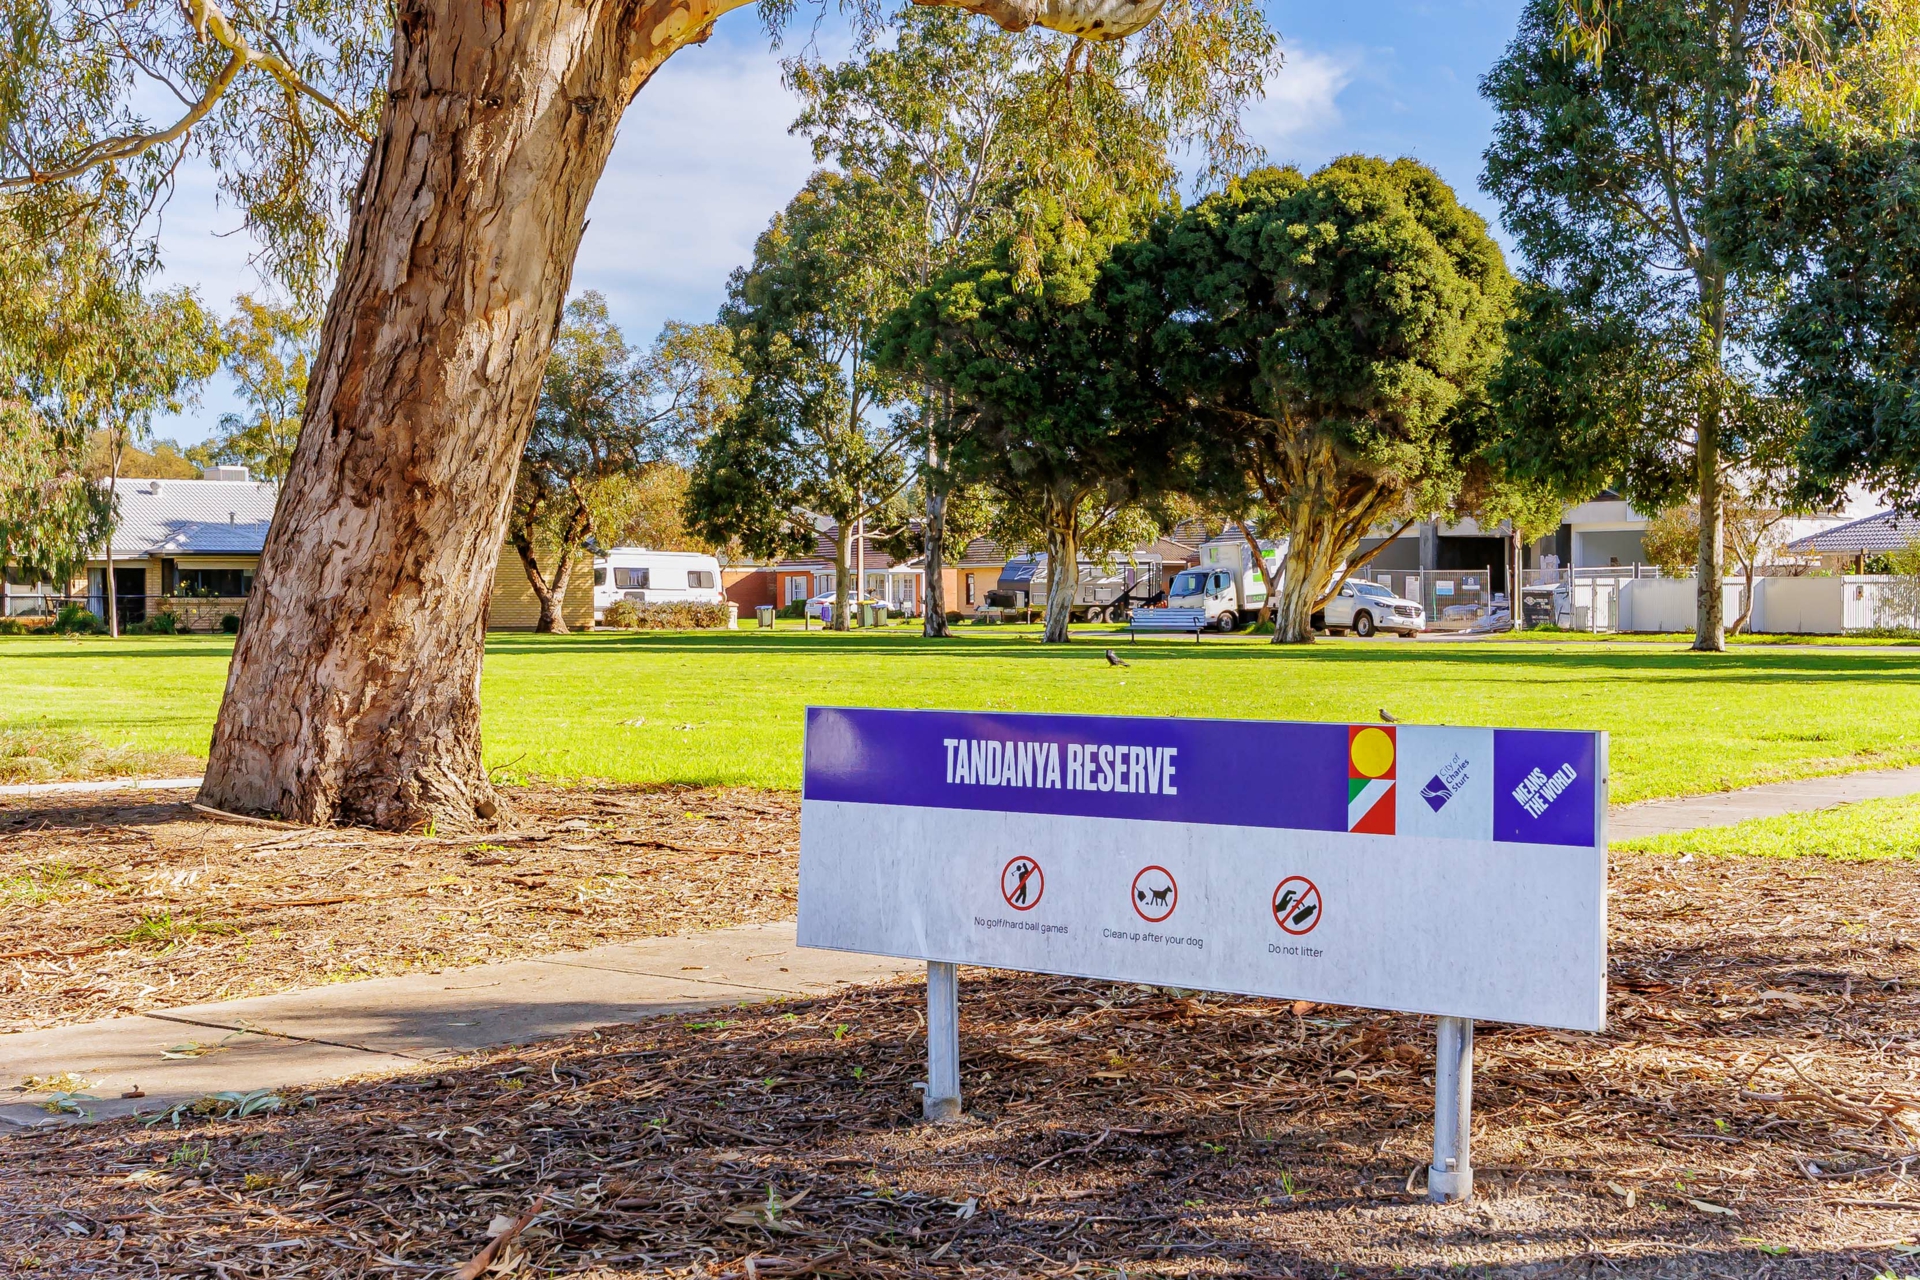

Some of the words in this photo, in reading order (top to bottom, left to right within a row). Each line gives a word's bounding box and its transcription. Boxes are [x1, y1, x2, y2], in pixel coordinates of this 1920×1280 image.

[944, 739, 1061, 789] TANDANYA
[1067, 744, 1178, 795] RESERVE
[1440, 762, 1454, 777] City
[1452, 752, 1461, 764] of
[1446, 759, 1470, 784] Charles
[1452, 773, 1470, 792] Sturt
[1512, 767, 1547, 806] MEANS
[1523, 792, 1549, 819] THE
[1539, 762, 1577, 803] WORLD
[974, 916, 985, 926] No
[987, 918, 1024, 929] golf/hard
[1025, 922, 1040, 931] ball
[1041, 924, 1069, 934] games
[1103, 928, 1128, 940] Clean
[1129, 933, 1141, 943] up
[1142, 932, 1164, 943] after
[1165, 936, 1184, 946] your
[1186, 936, 1204, 949] dog
[1268, 943, 1281, 954] Do
[1283, 946, 1299, 956] not
[1300, 946, 1323, 958] litter
